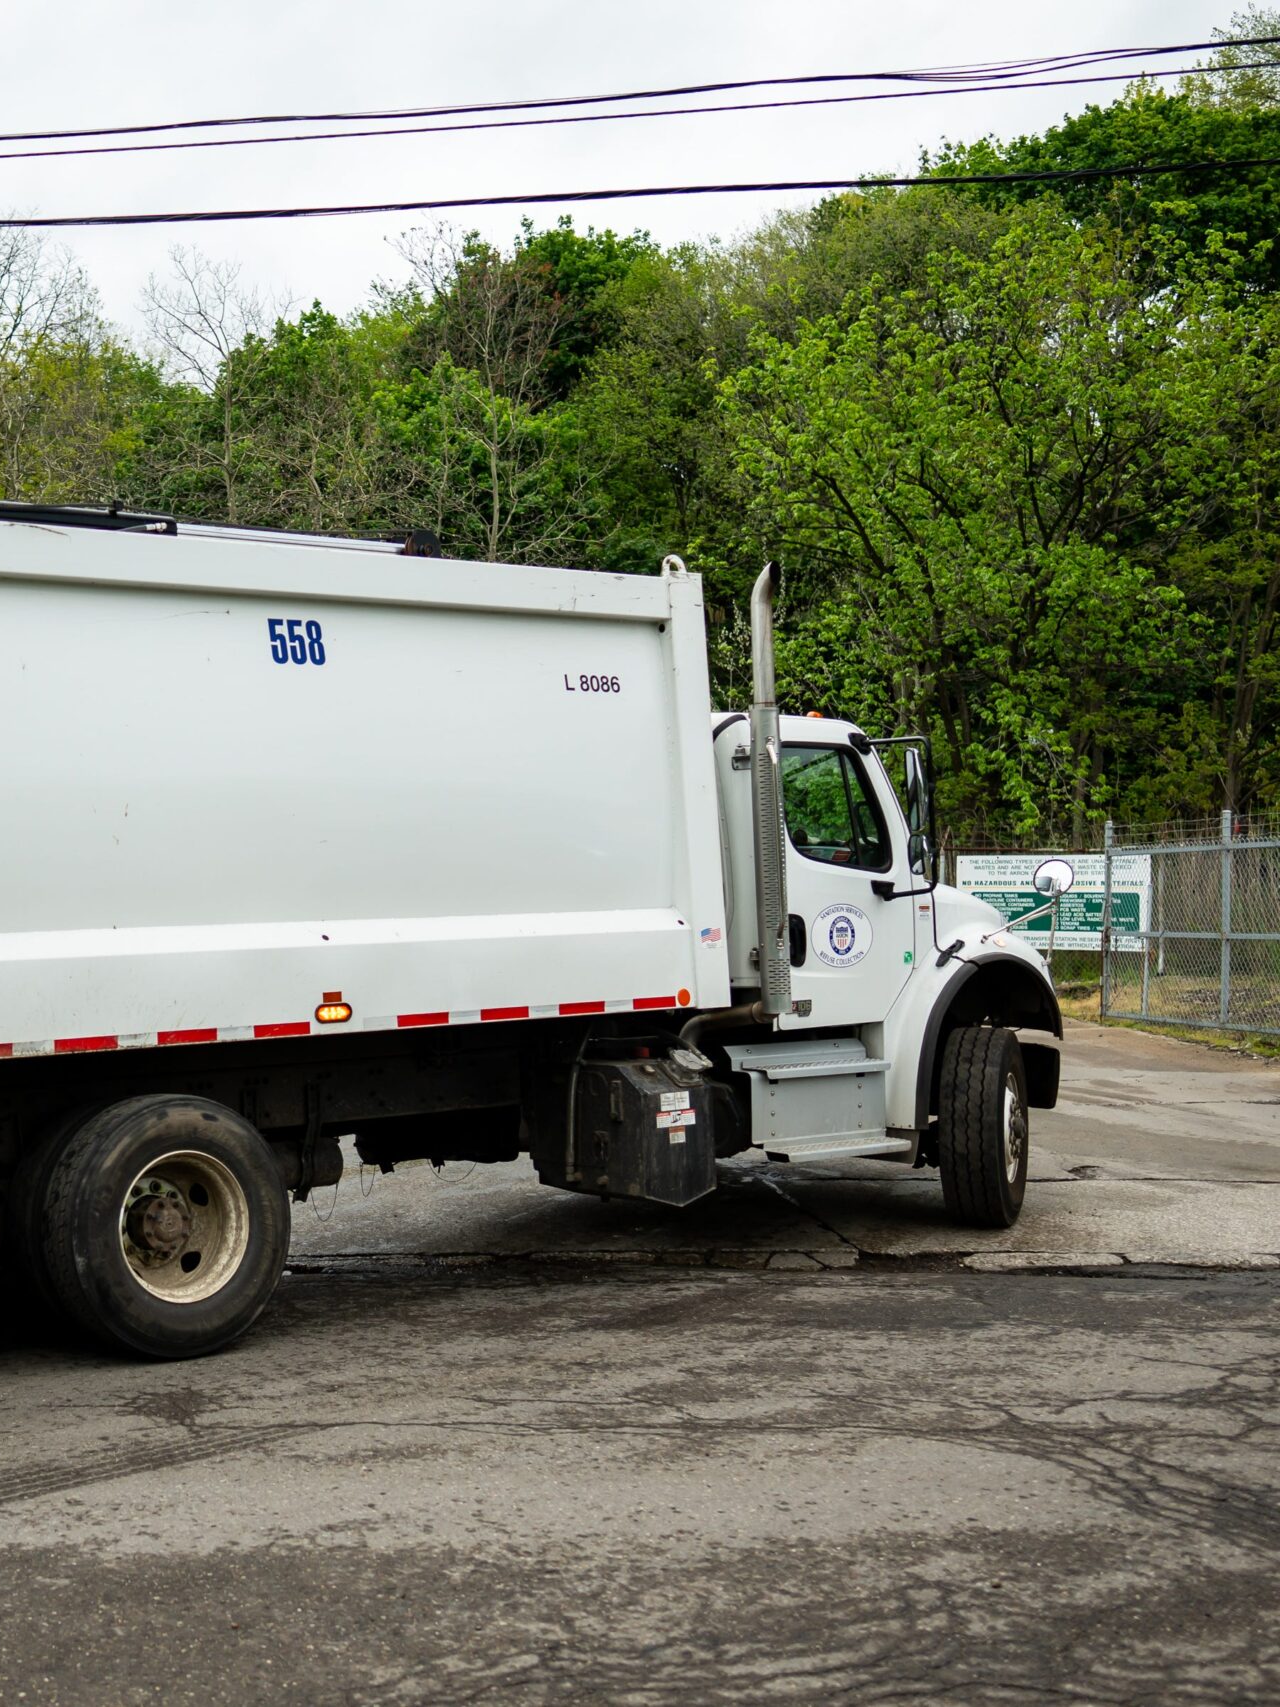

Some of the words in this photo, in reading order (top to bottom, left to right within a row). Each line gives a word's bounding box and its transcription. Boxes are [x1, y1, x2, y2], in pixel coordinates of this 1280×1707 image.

[267, 618, 326, 665] 558
[564, 674, 575, 691] L
[580, 675, 620, 693] 8086
[820, 906, 844, 920] SANITATION
[845, 906, 864, 920] SERVICES
[820, 950, 835, 964] REFUSE
[836, 951, 864, 966] COLLECTION
